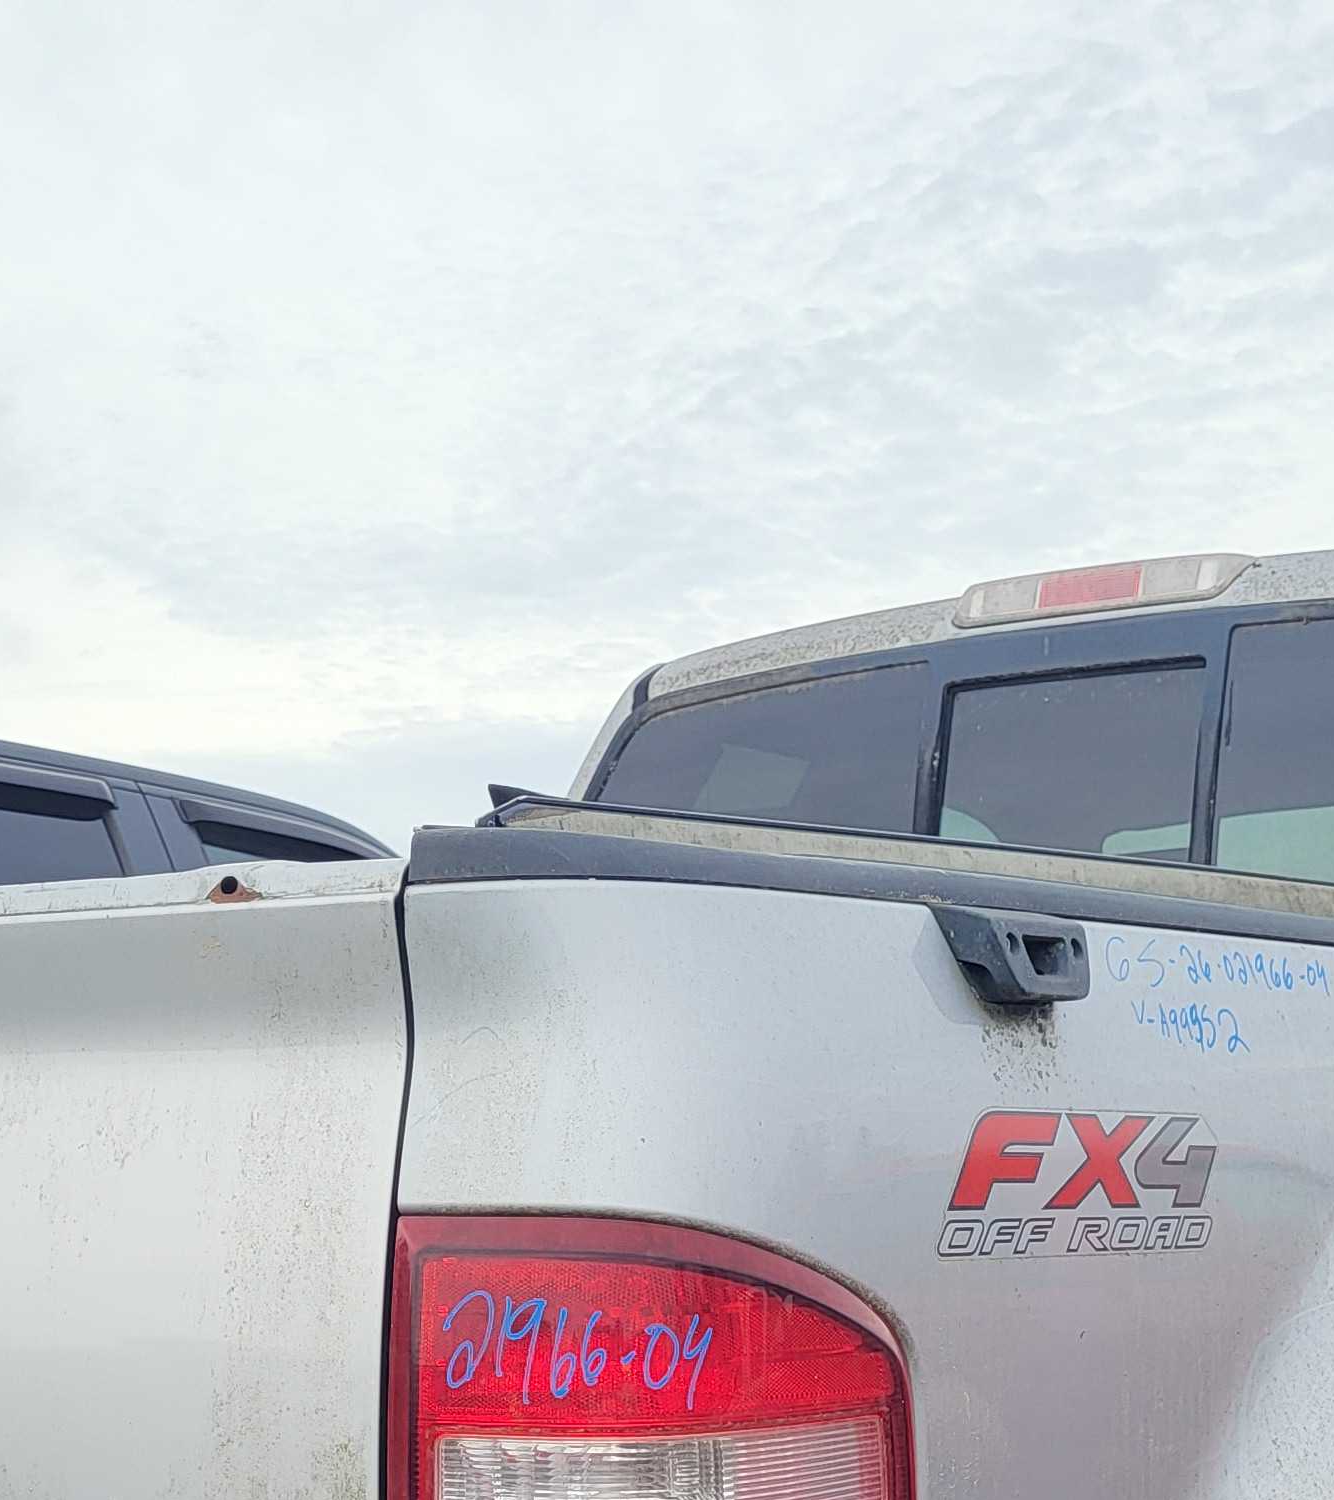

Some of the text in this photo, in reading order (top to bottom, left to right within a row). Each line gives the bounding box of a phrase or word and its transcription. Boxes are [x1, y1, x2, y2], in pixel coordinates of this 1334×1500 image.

[947, 1112, 1218, 1211] FX4
[937, 1215, 1212, 1257] OFF ROAD
[443, 1290, 713, 1409] 21966-04
